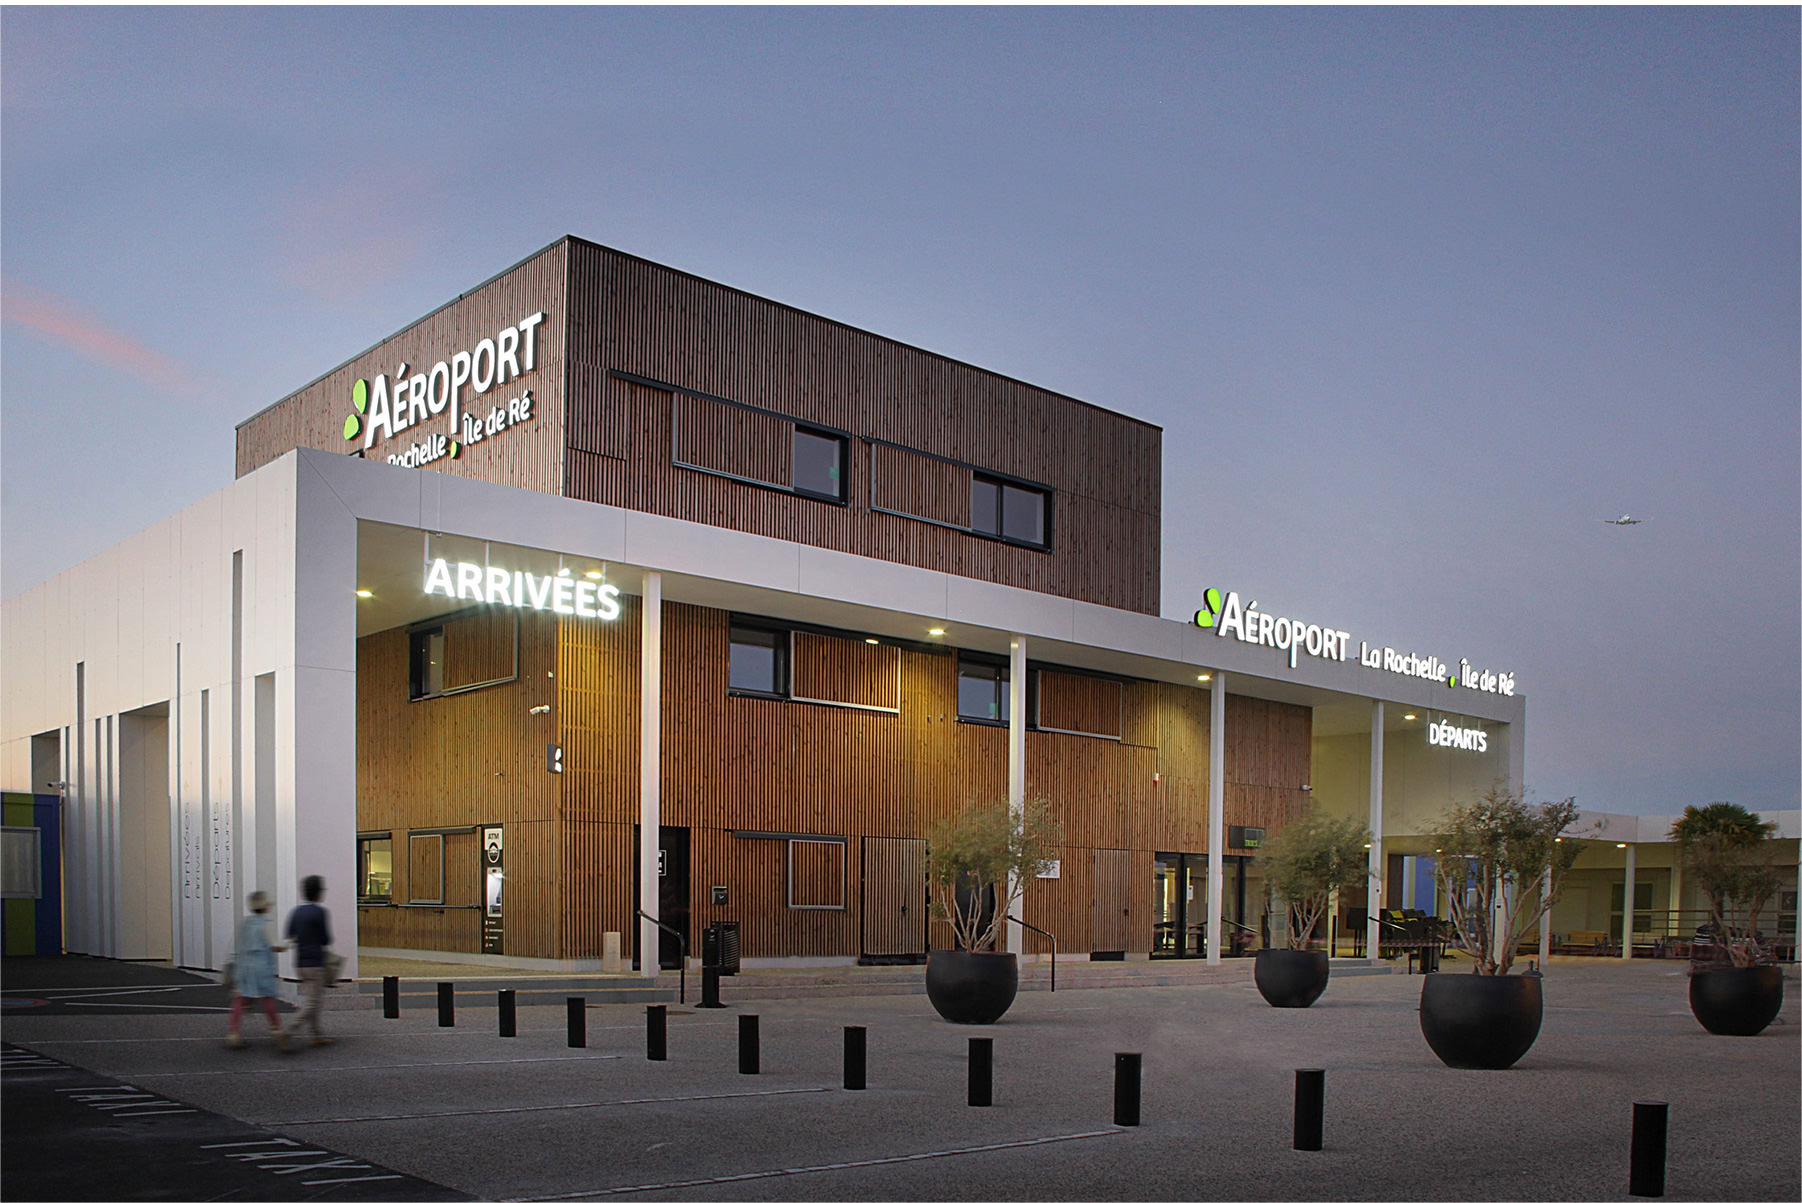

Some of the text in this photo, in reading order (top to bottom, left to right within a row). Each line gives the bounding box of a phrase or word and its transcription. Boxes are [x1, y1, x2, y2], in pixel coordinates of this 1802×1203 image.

[364, 311, 543, 449] AÉROPORT
[463, 412, 483, 446] Île
[486, 407, 506, 436] de
[509, 391, 532, 425] Ré
[424, 558, 620, 620] ARRIVÉES
[1217, 591, 1515, 696] AÉROPORT La Rochelle Île de Ré
[1429, 718, 1487, 752] DÉPARTS
[54, 1085, 199, 1117] TAXI
[200, 1138, 405, 1186] TAXI
